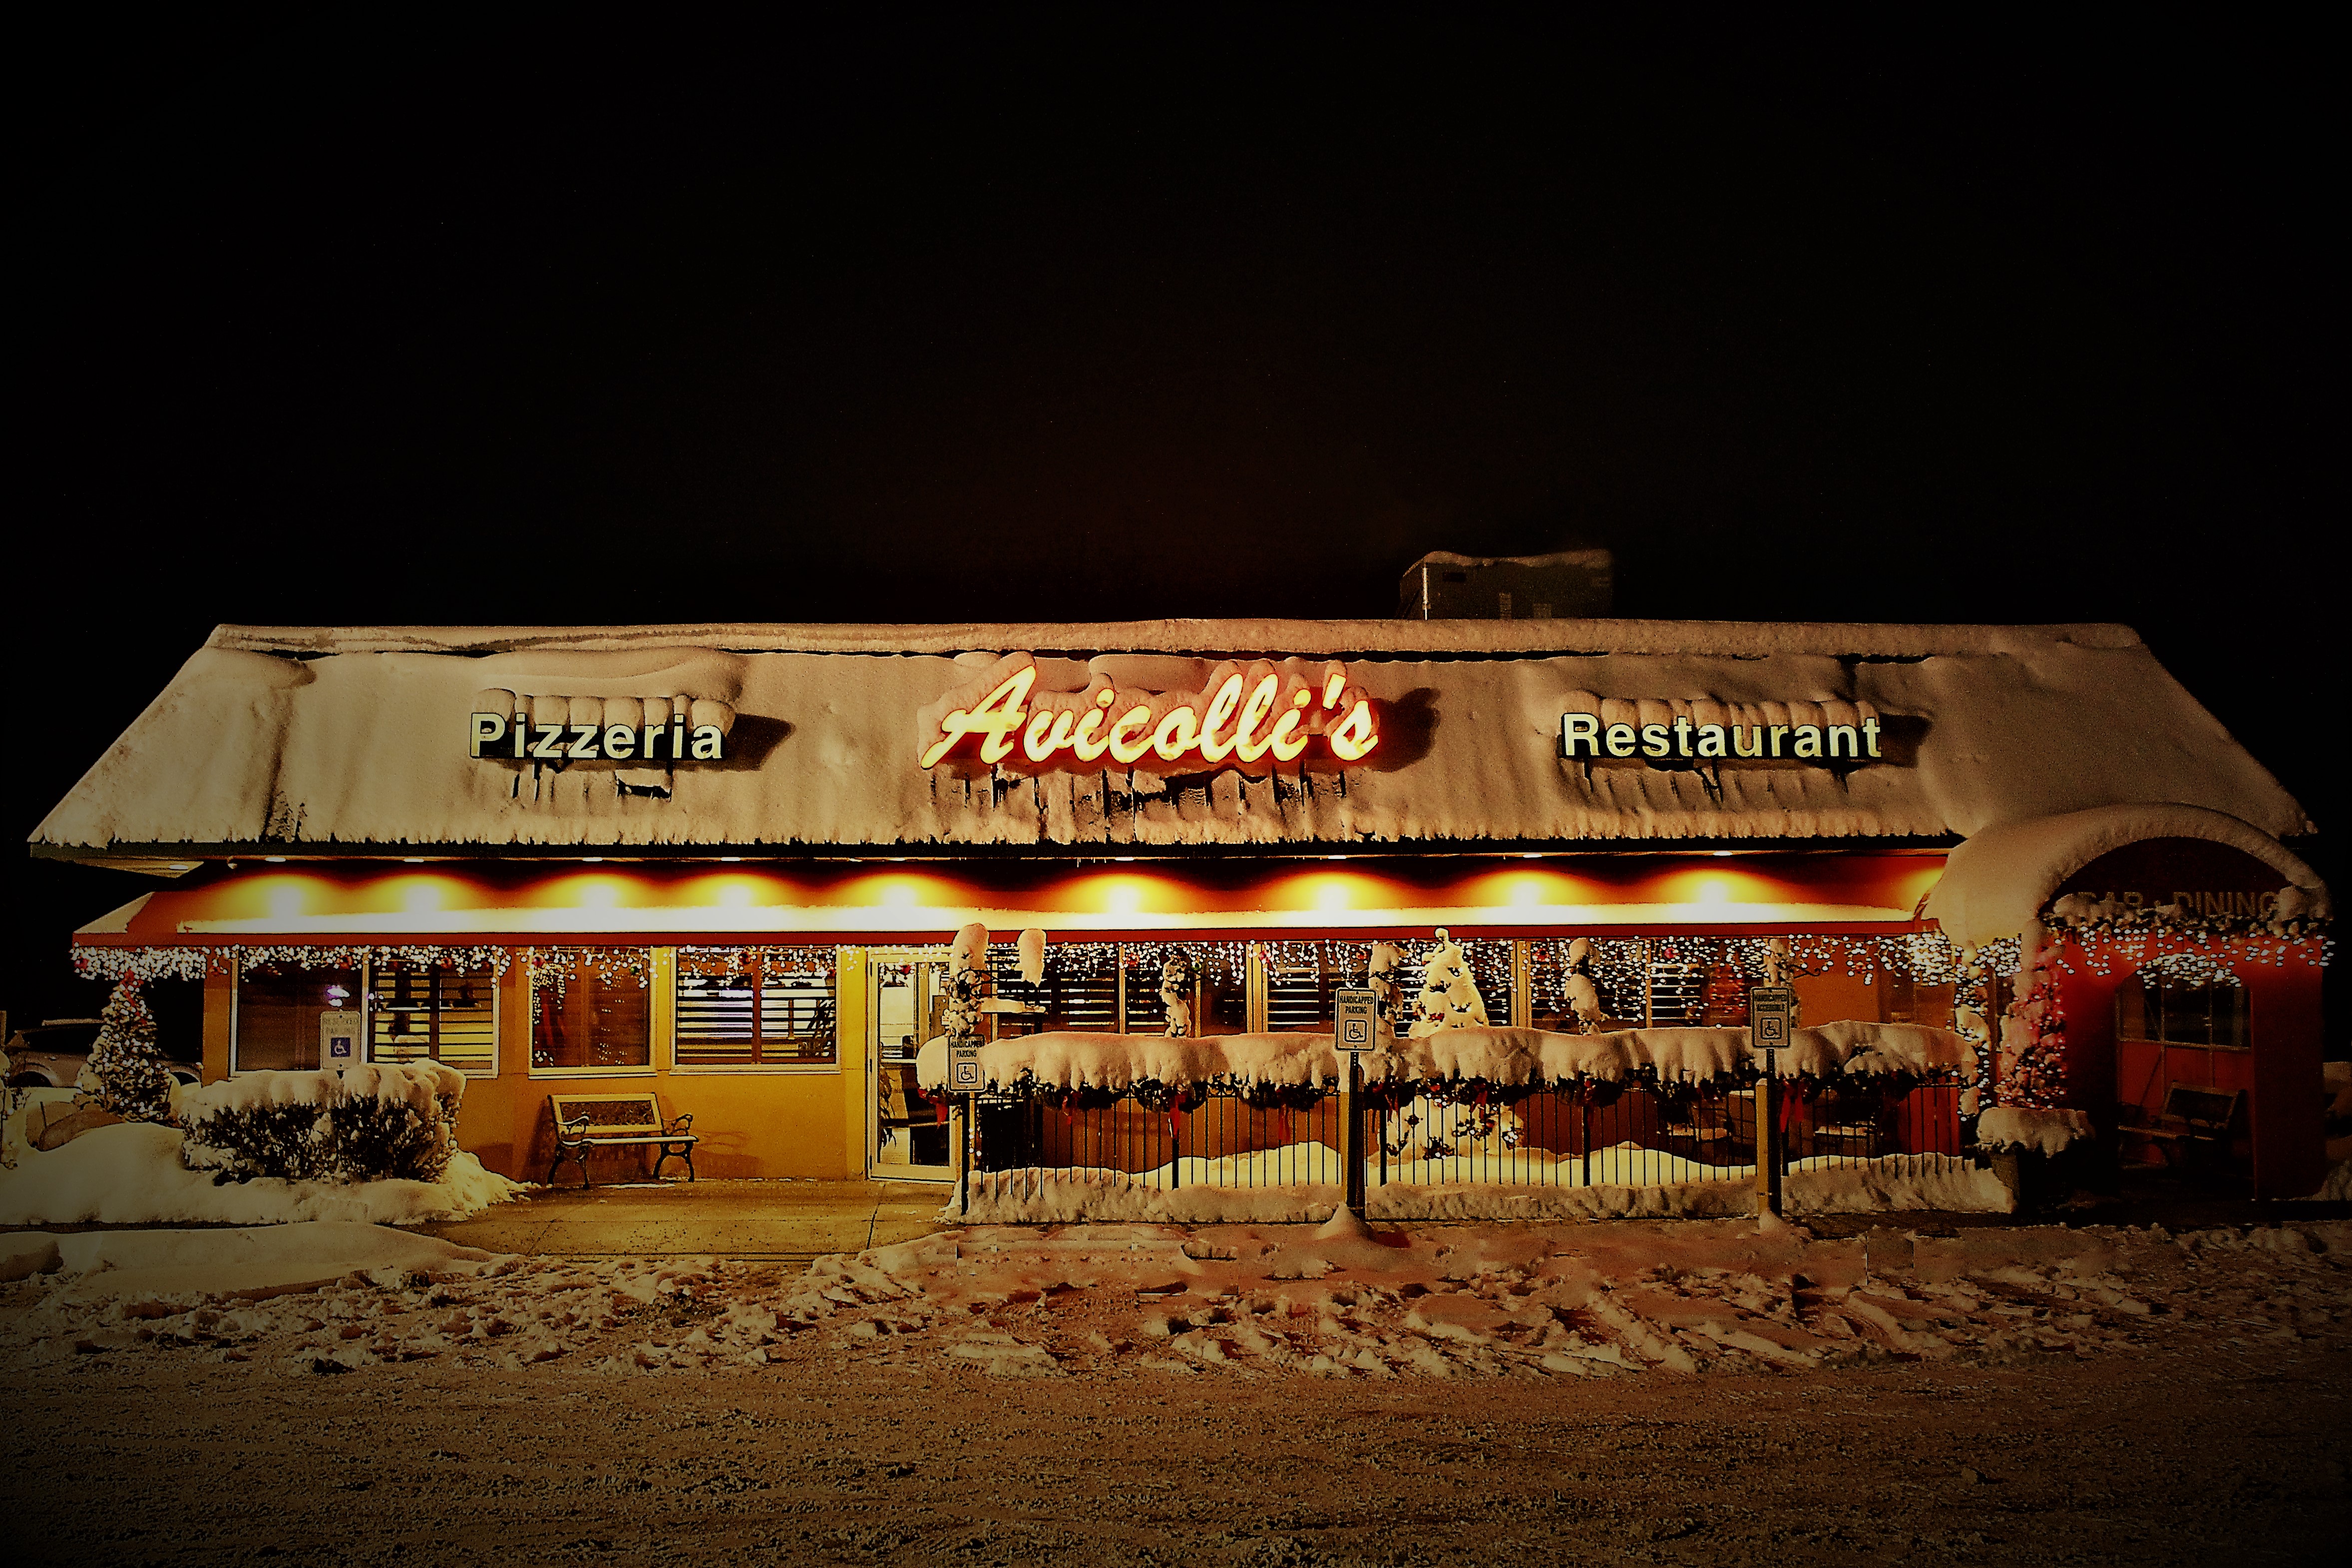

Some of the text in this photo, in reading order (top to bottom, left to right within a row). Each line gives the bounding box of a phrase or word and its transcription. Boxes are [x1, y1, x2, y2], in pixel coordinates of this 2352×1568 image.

[470, 712, 723, 759] Pizzeria
[920, 664, 1379, 770] Avicolli's
[1563, 713, 1882, 758] Restaurant
[1339, 996, 1374, 1004] HANDICAPPED
[1345, 1006, 1367, 1014] PARKING
